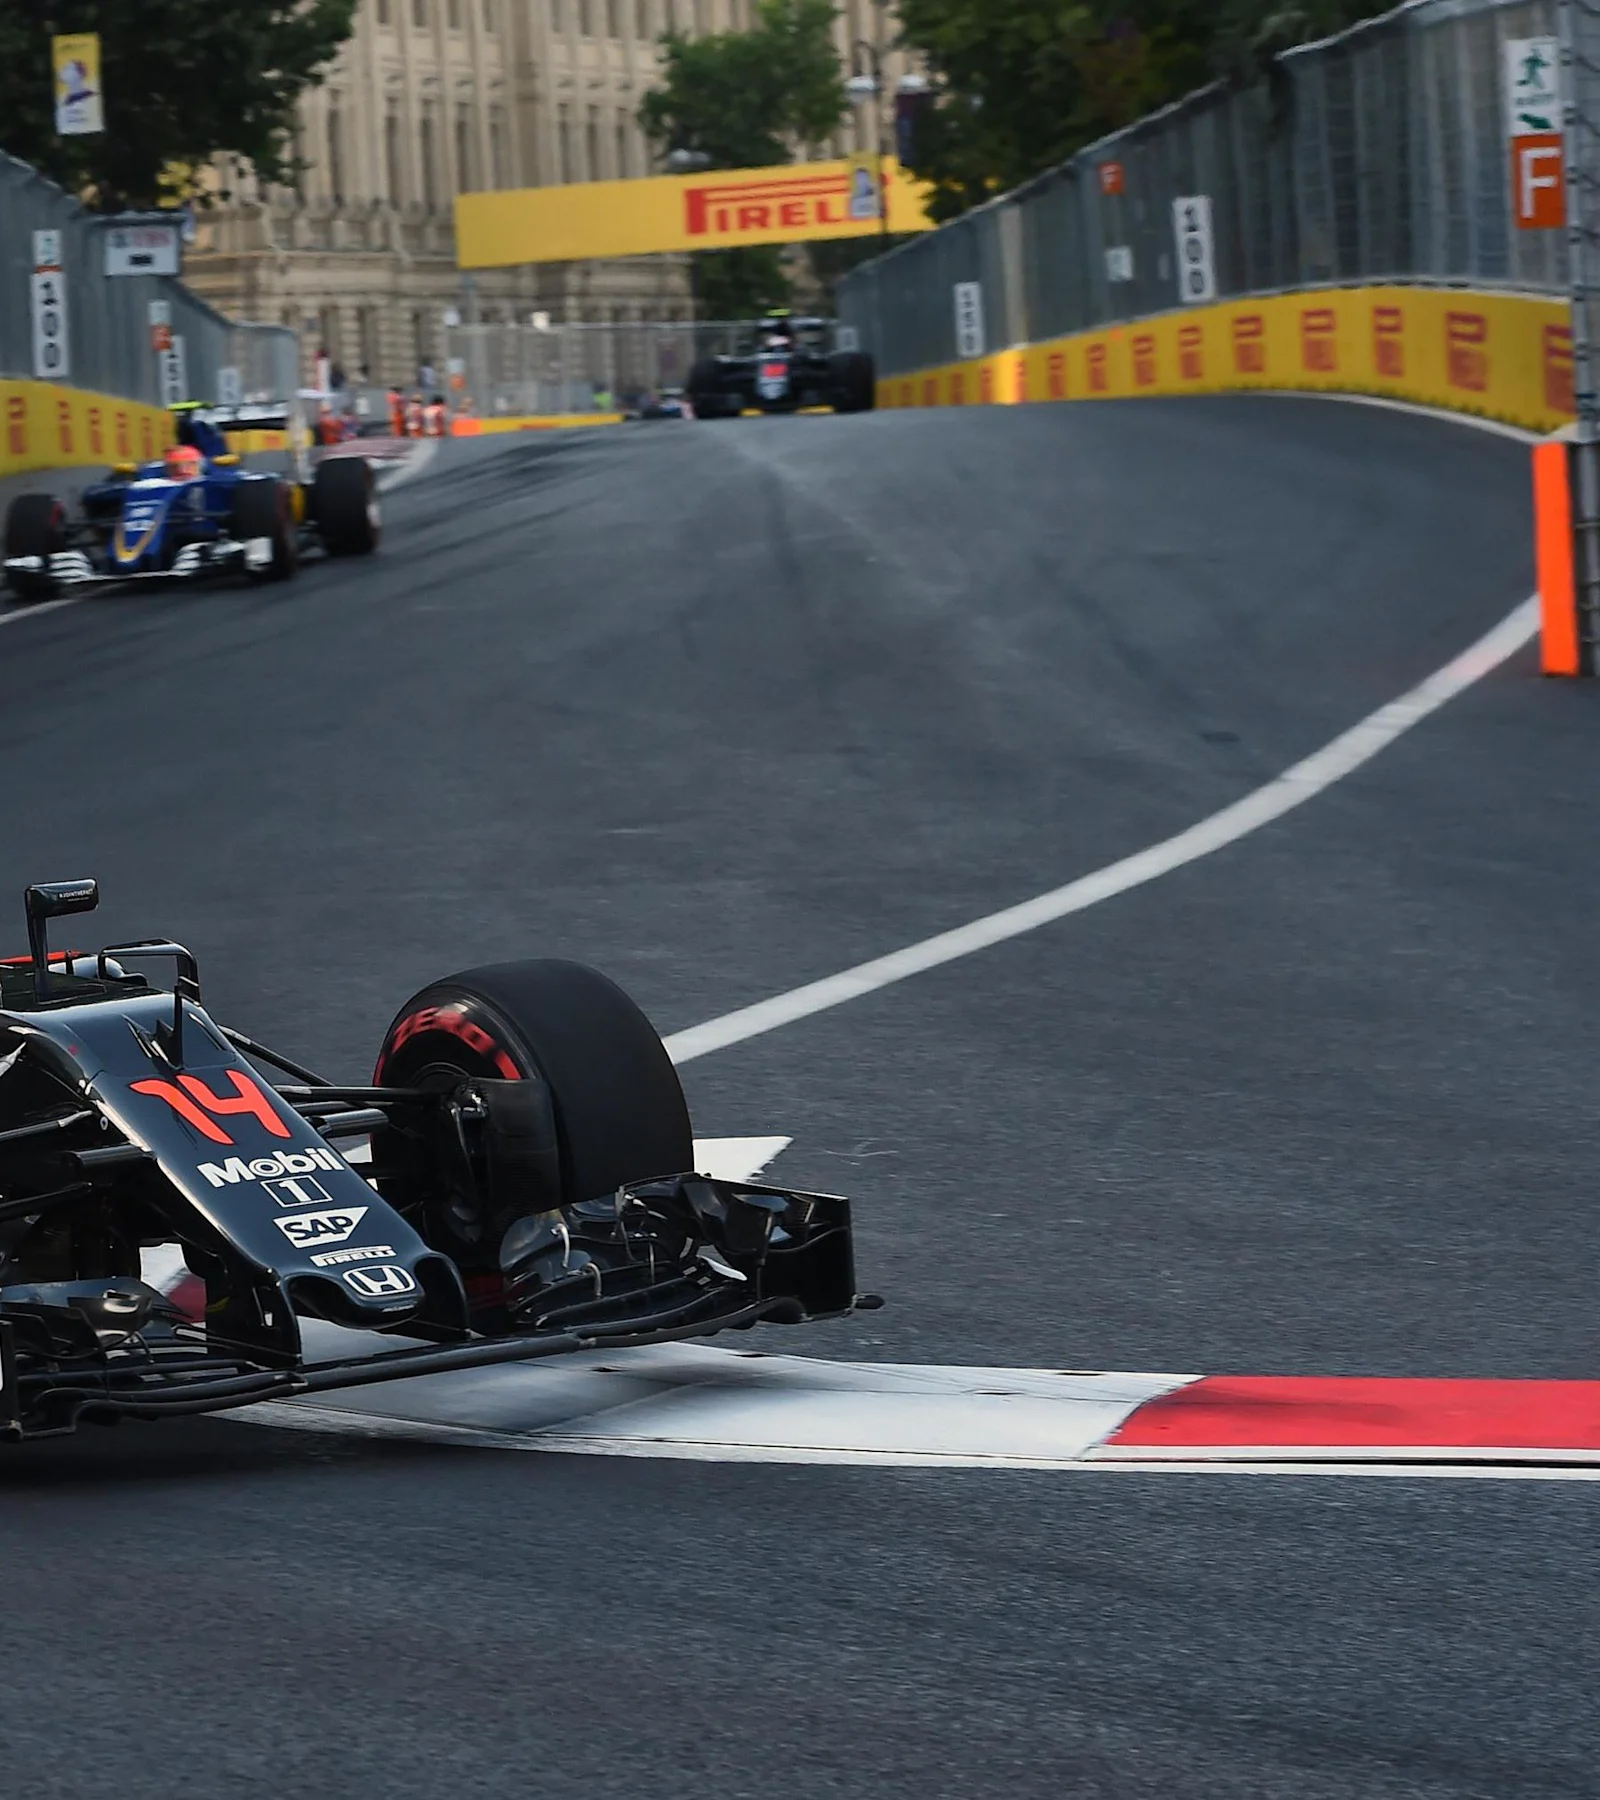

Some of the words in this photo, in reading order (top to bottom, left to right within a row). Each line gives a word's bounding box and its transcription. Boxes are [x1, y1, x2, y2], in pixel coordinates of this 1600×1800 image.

[685, 174, 888, 235] PIREL
[1521, 147, 1561, 219] F
[40, 281, 62, 368] 100
[129, 1069, 293, 1146] 14
[197, 1148, 345, 1189] Mobil
[284, 1215, 354, 1241] SAP
[310, 1245, 397, 1268] PIRELLI
